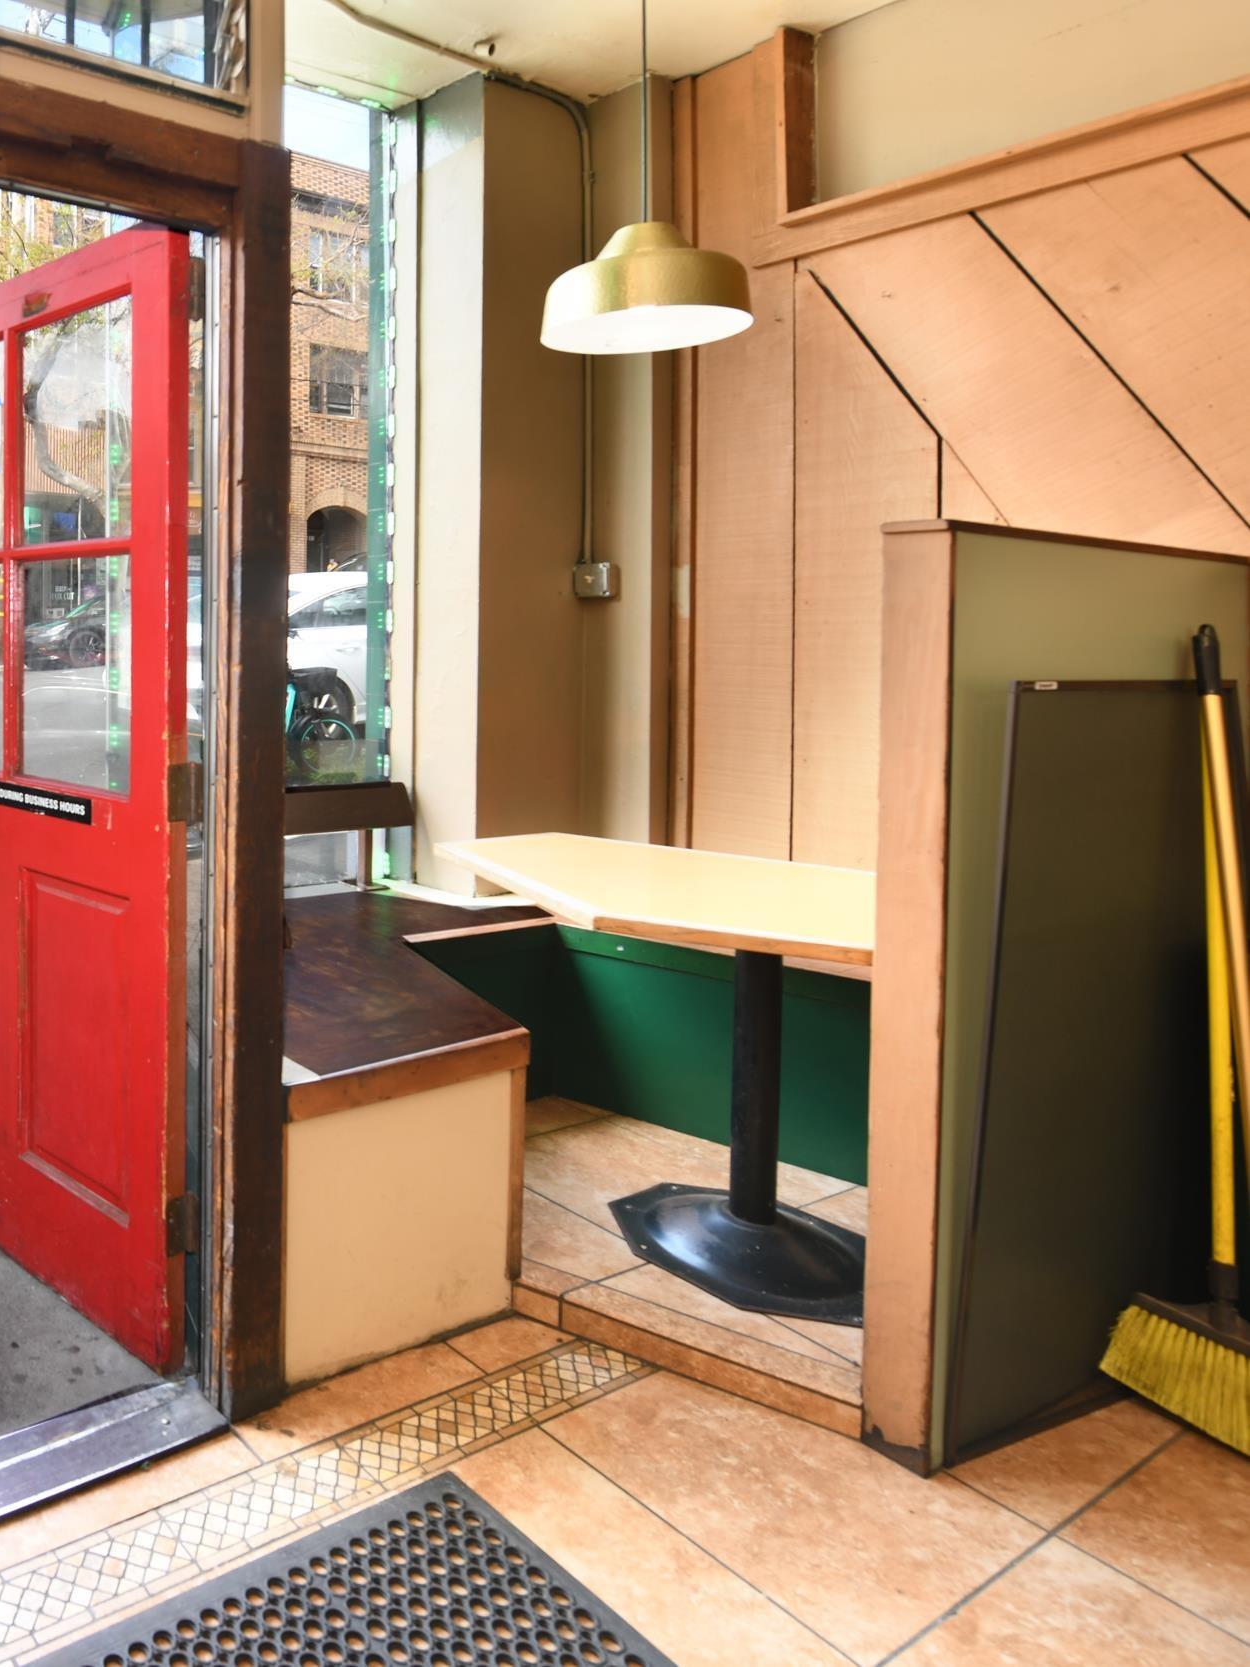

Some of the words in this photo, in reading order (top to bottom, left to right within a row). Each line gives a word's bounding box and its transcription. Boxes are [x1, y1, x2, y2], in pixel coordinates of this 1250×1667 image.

[0, 788, 24, 803] DURING
[24, 793, 59, 810] BUSINESS
[59, 800, 86, 815] HOURS
